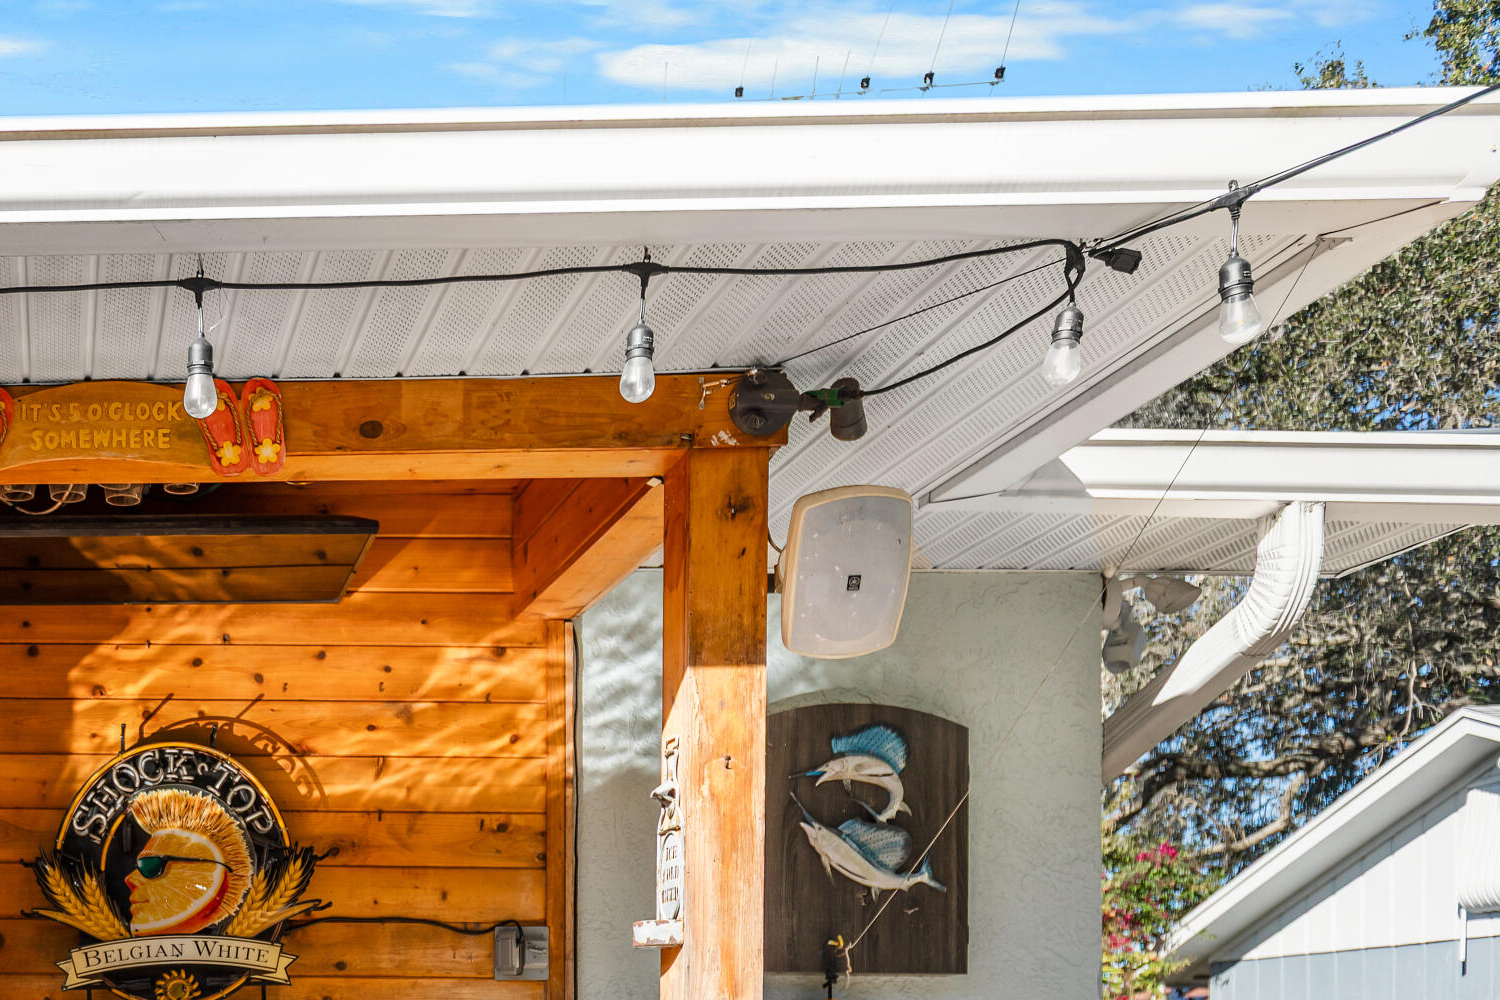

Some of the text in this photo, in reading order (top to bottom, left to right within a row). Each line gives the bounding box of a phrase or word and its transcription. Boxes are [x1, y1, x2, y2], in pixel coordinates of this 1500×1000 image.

[20, 400, 184, 422] IT'S 5 O'CLOCK
[30, 428, 173, 451] SOMEWHERE
[72, 748, 276, 845] SHOCK TOP
[83, 939, 270, 969] BELGIAN WHITE
